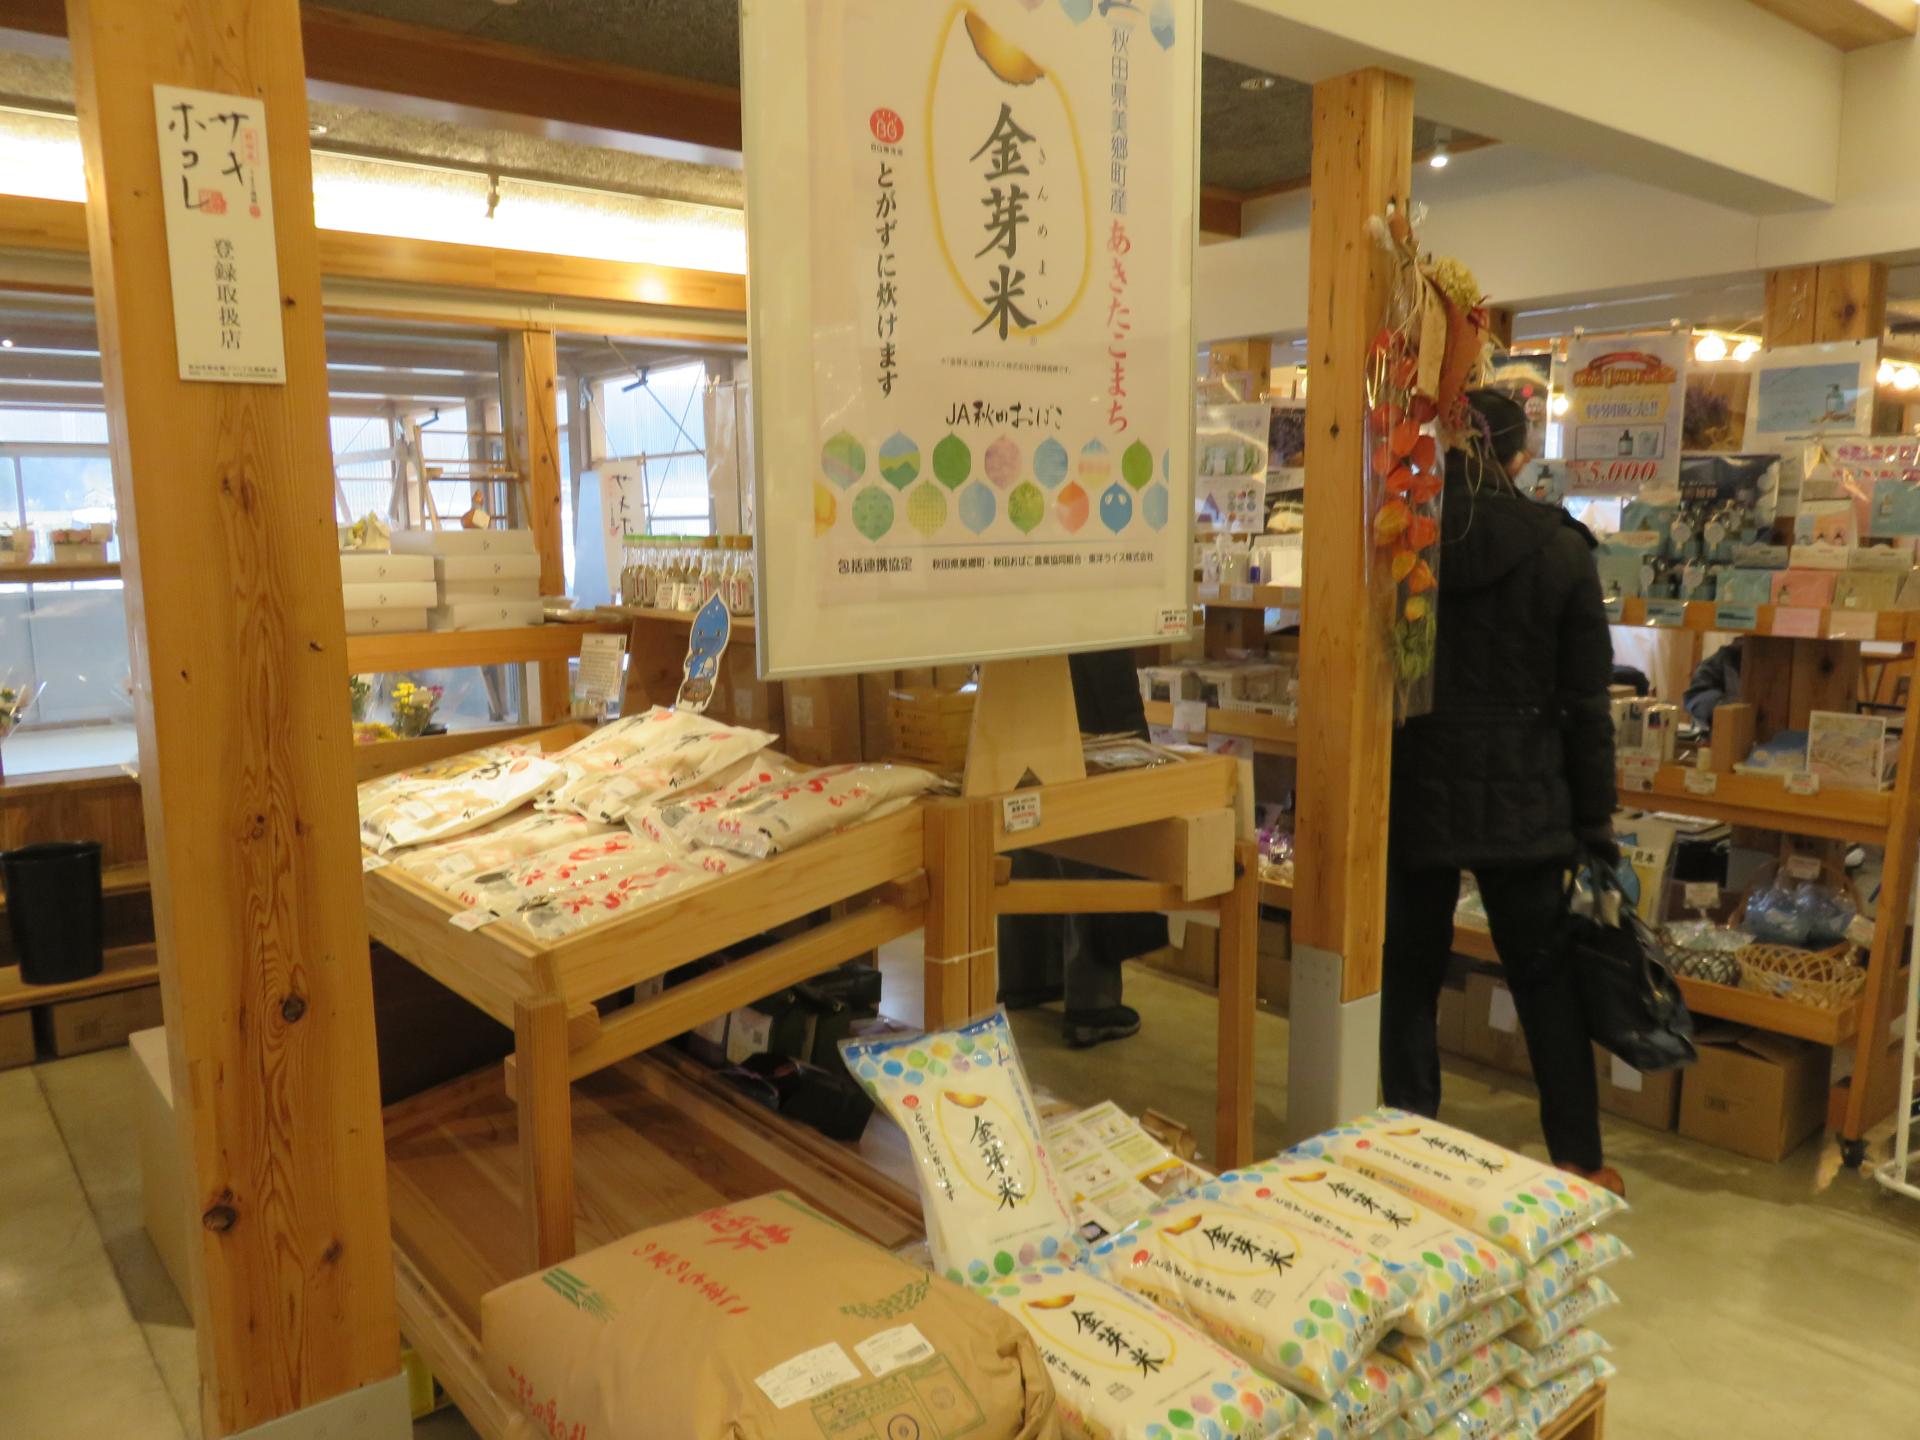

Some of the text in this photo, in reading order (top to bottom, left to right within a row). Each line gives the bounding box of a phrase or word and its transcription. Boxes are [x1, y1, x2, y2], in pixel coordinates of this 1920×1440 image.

[969, 102, 1037, 341] 金芽米
[214, 238, 241, 350] 登録取扱店
[875, 162, 898, 399] とがずに炊けます
[1106, 219, 1131, 433] あきたこまち
[837, 556, 913, 575] 包括連携協定
[1201, 1224, 1295, 1277] 金芽米
[1070, 1309, 1166, 1380] 金芽米
